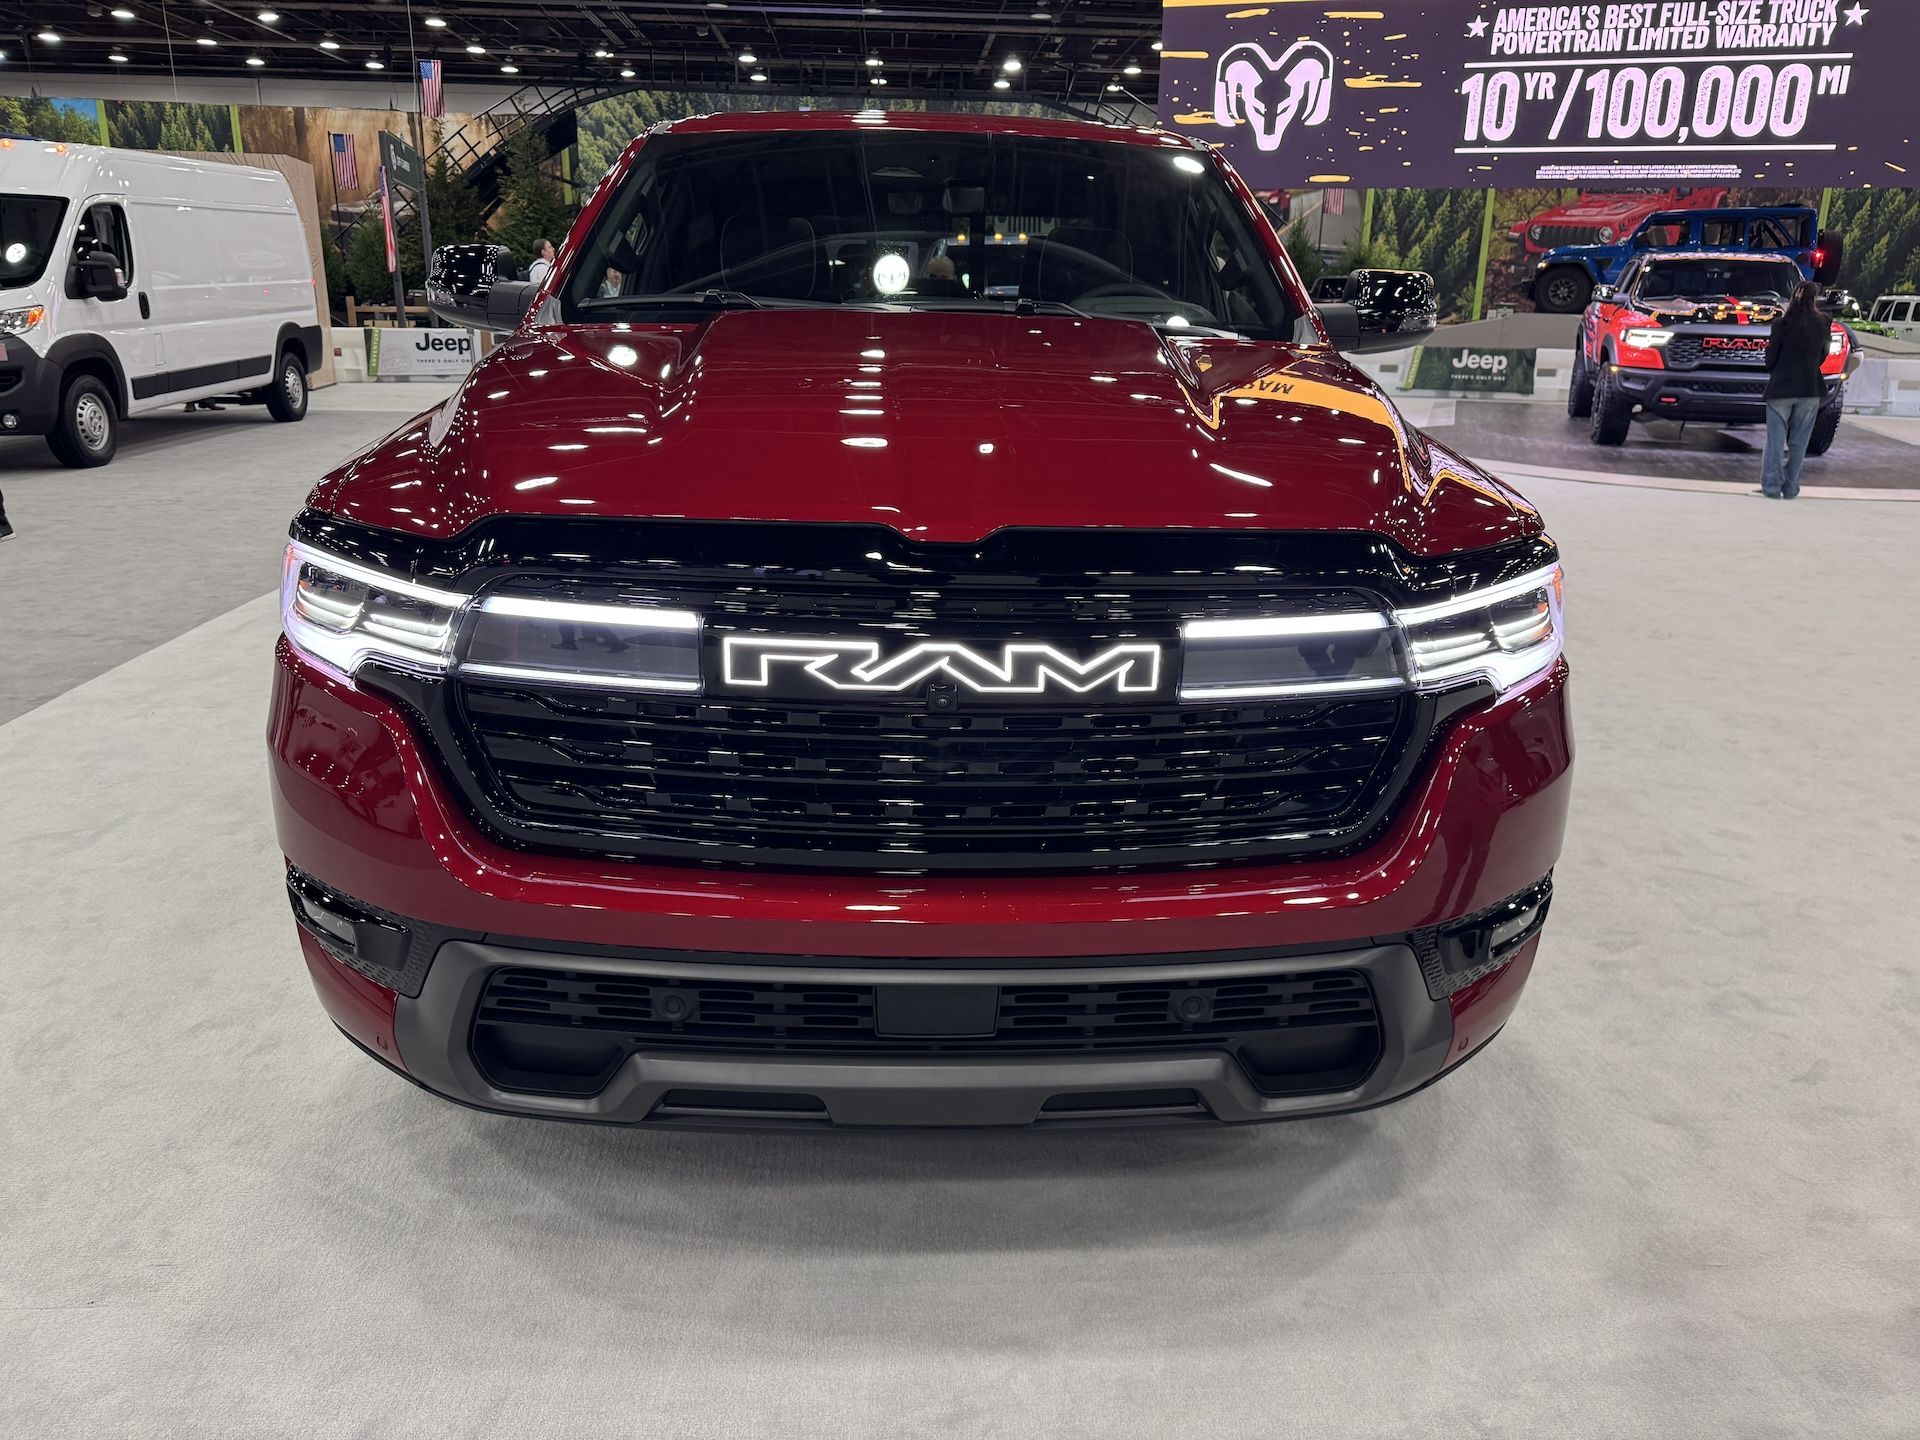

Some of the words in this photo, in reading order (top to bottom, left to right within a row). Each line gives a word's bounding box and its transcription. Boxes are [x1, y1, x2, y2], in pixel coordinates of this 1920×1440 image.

[1493, 5, 1600, 32] AMERICA'S
[1604, 2, 1656, 29] BEST
[1659, 0, 1761, 27] FULL-SIZE
[1768, 0, 1839, 23] TRUCK
[1490, 29, 1623, 56] POWERTRAIN
[1626, 25, 1710, 51] LIMITED
[1716, 22, 1838, 49] WARRANTY
[415, 333, 471, 355] Jeep
[1452, 349, 1508, 373] Jeep
[722, 636, 1161, 692] RAM
